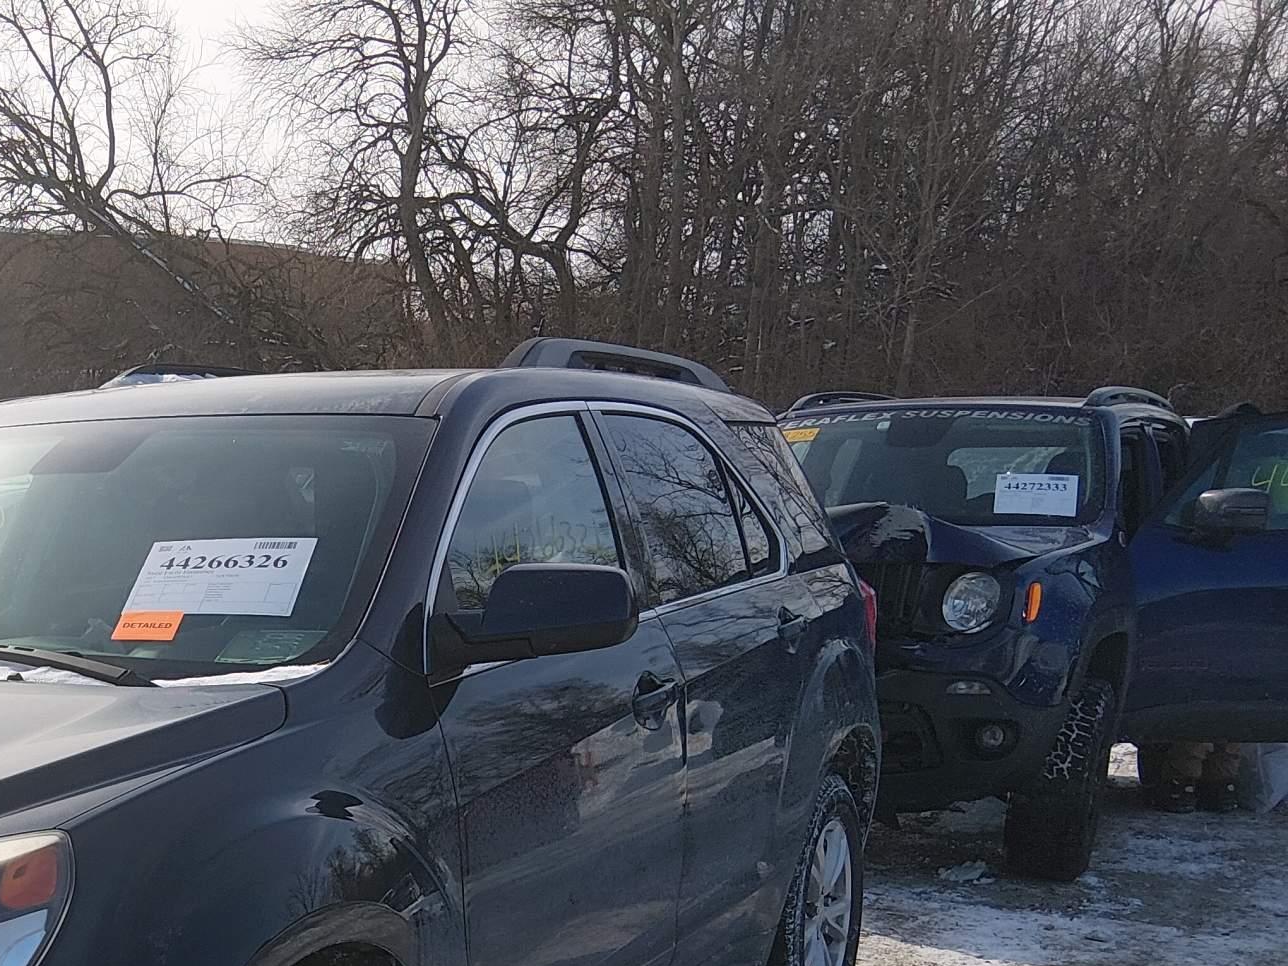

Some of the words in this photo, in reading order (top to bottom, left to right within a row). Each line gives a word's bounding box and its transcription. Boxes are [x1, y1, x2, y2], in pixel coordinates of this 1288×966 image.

[901, 410, 1093, 426] SUSPENSIONS
[1004, 482, 1067, 491] 44272333
[160, 554, 290, 569] 44266326
